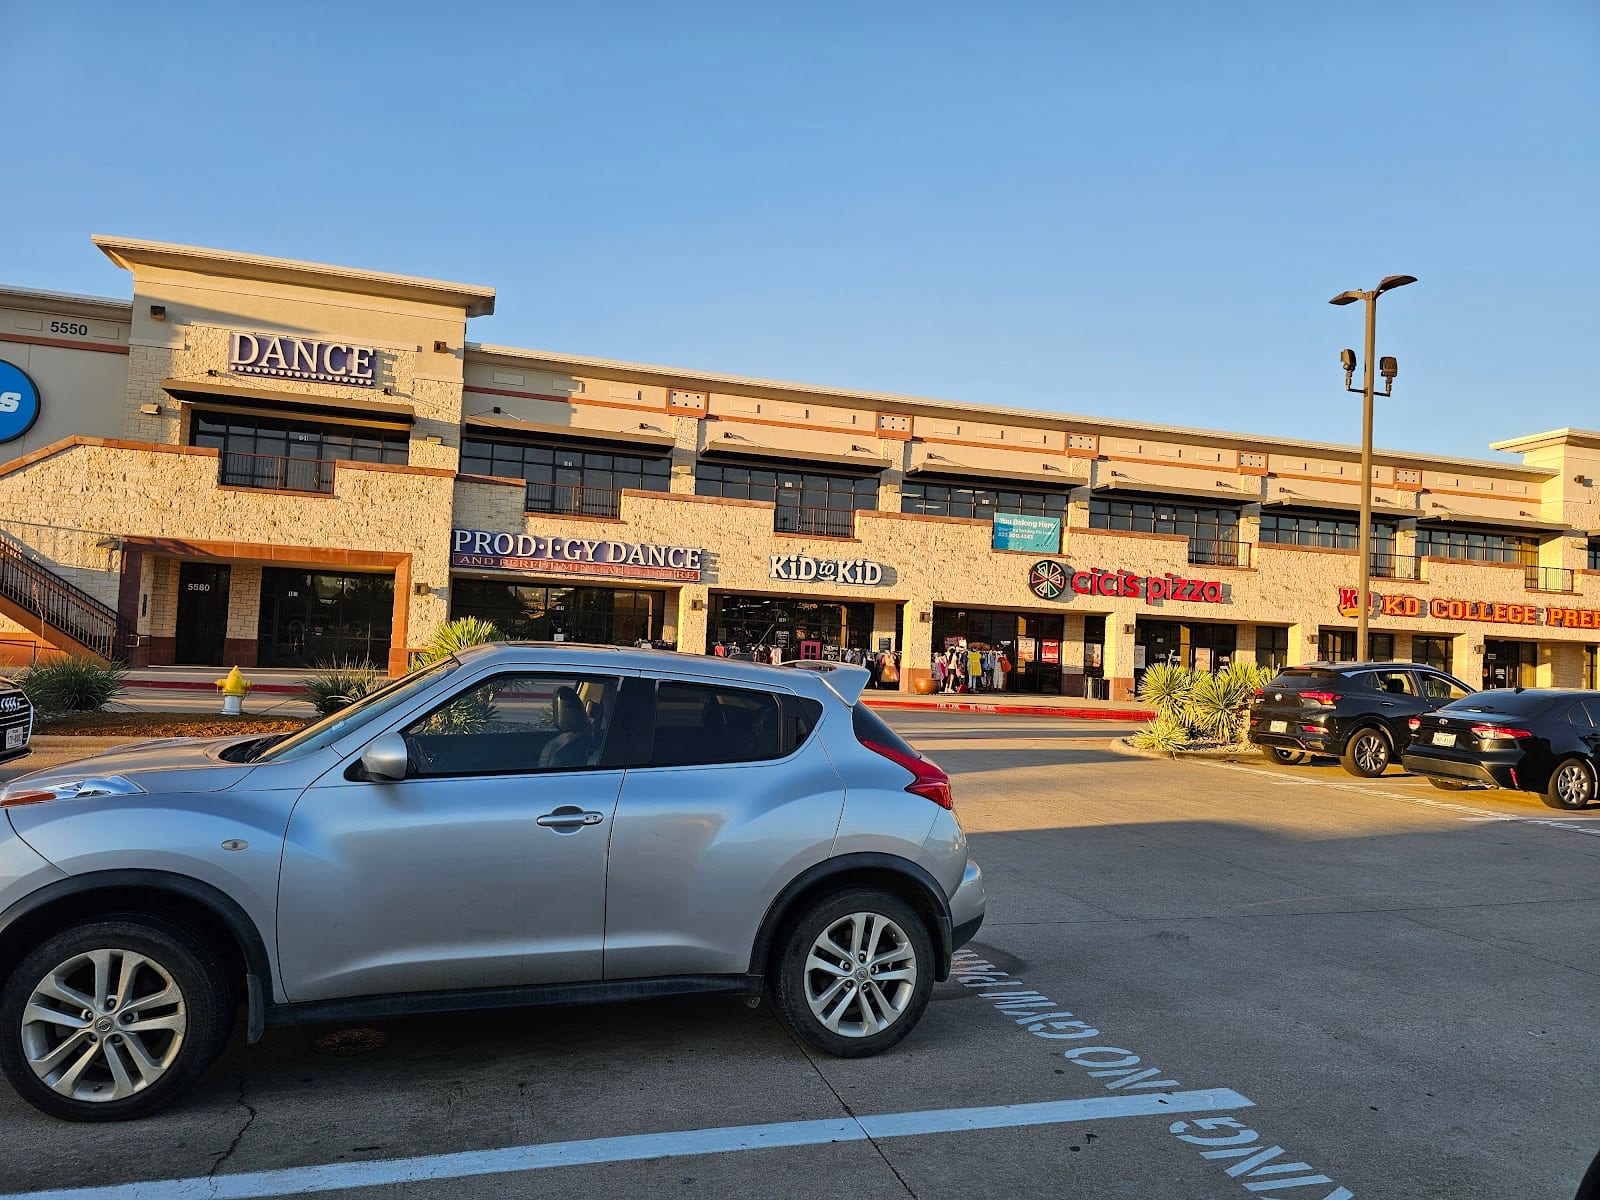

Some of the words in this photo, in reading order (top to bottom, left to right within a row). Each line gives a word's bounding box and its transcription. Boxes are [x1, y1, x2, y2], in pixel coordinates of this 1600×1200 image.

[50, 321, 88, 336] 5550
[230, 332, 374, 379] DANCE
[1000, 517, 1012, 525] You
[1013, 519, 1038, 528] Belong
[459, 555, 494, 566] AND
[606, 541, 703, 570] DANCE
[819, 561, 836, 577] to
[187, 583, 211, 592] 5580
[1071, 567, 1141, 597] cicis
[1146, 572, 1224, 606] pizza
[1382, 594, 1421, 617] KD
[1430, 598, 1538, 625] COLLEGE
[1064, 1046, 1181, 1090] NO
